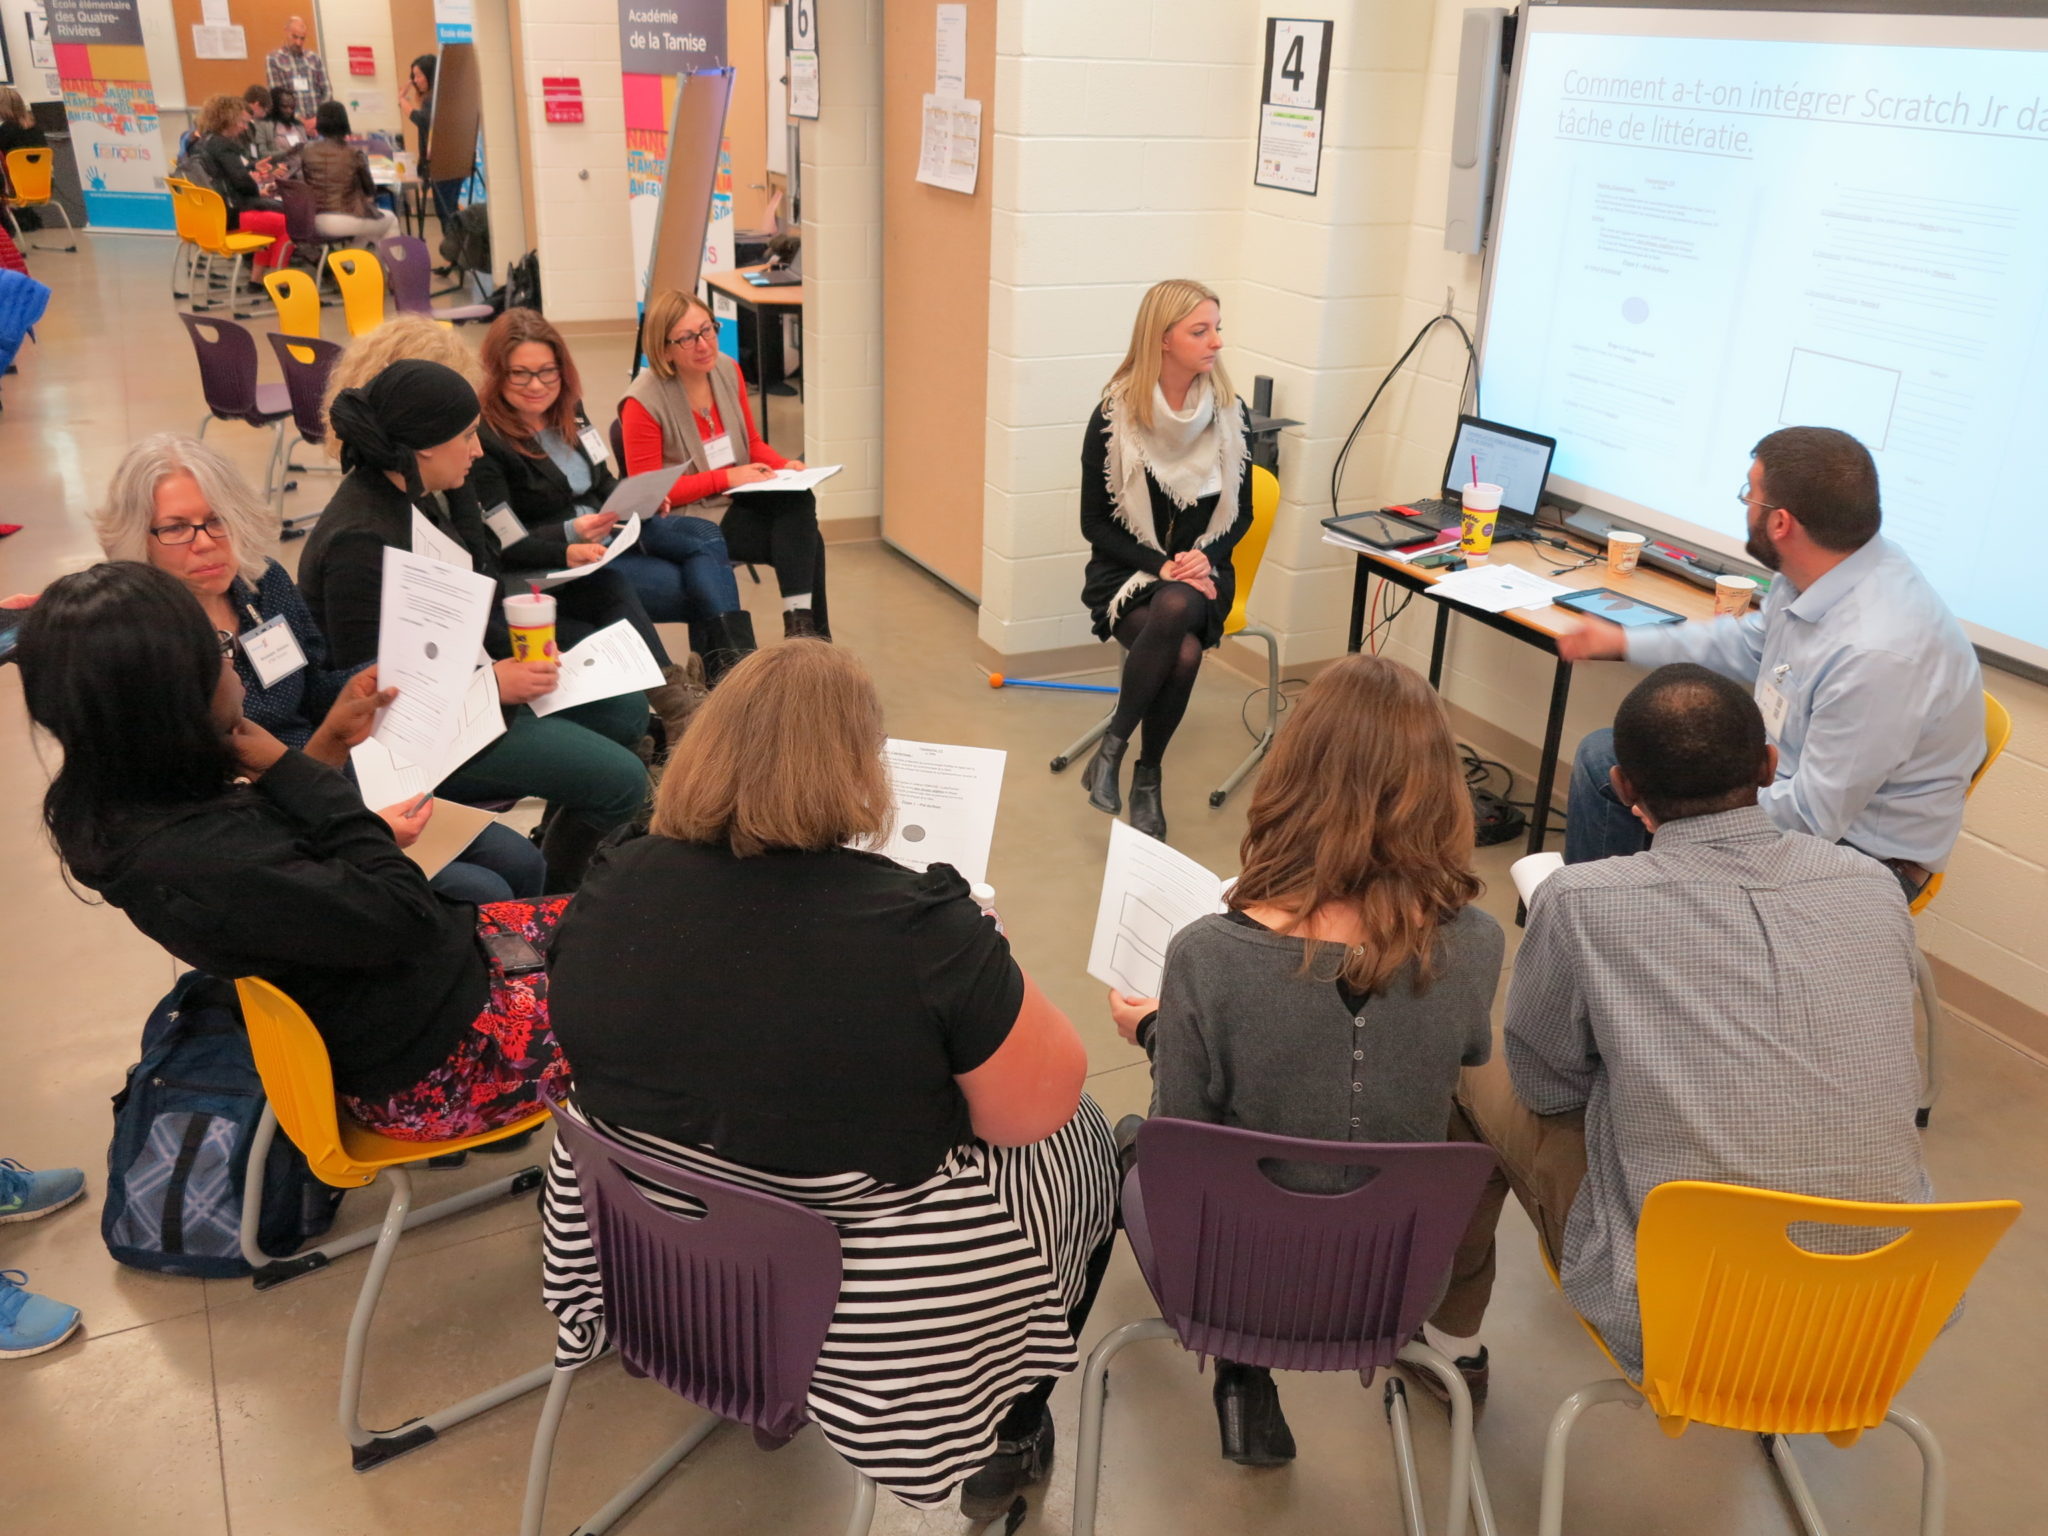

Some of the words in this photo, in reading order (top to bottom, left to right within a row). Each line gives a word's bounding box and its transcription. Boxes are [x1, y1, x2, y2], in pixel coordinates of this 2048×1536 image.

[55, 11, 75, 22] des
[77, 11, 119, 23] Quatre-
[629, 8, 678, 24] Académie
[57, 24, 102, 37] Rivières
[630, 31, 646, 49] de
[648, 31, 660, 49] la
[662, 32, 707, 52] Tamise
[1281, 35, 1305, 92] 4
[1563, 69, 1667, 101] Comment
[1672, 79, 1742, 108] a-t-on
[1750, 81, 1856, 119] intégrer
[1860, 88, 1970, 126] Scratch
[1977, 96, 2009, 128] Jr
[1558, 108, 1613, 138] tâche
[1618, 112, 1646, 141] de
[1650, 114, 1754, 153] littératie.
